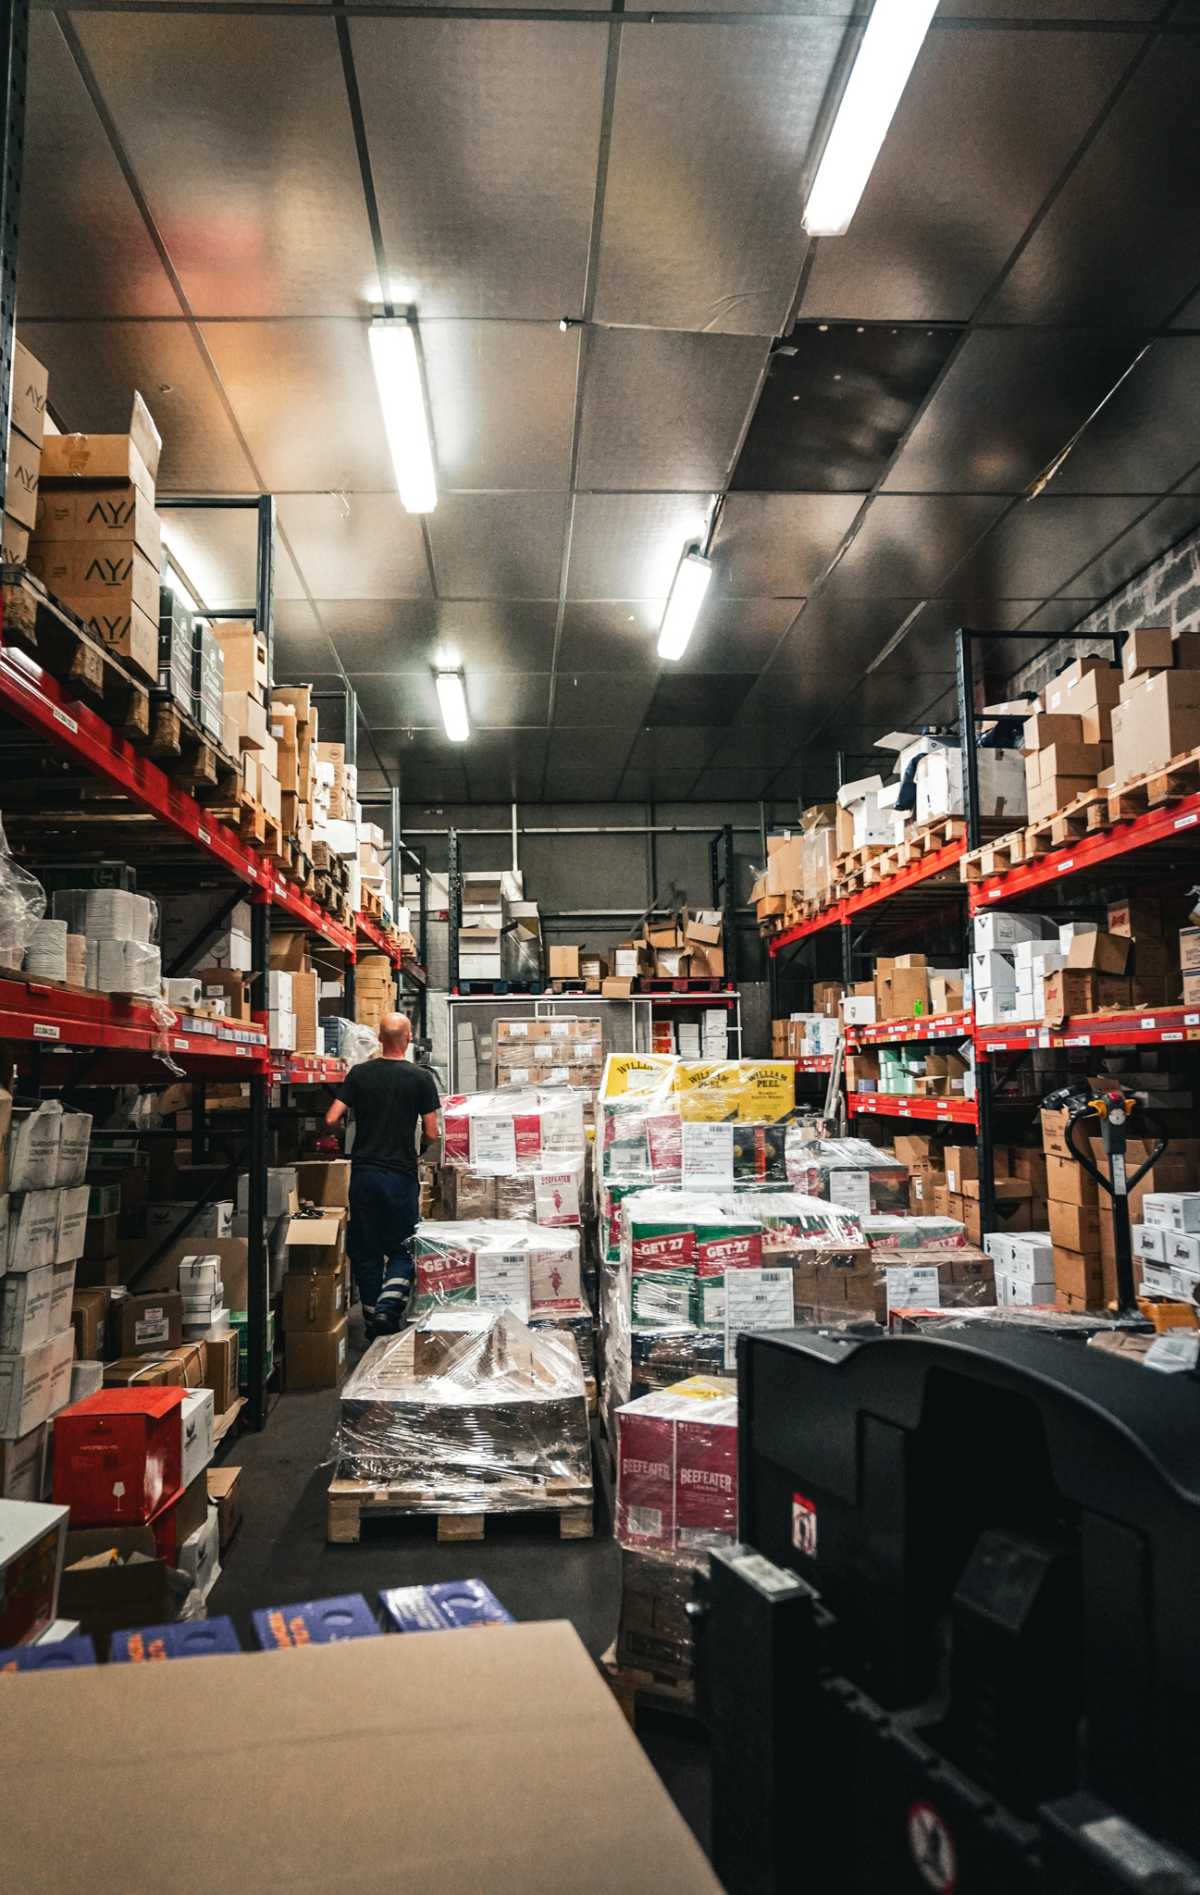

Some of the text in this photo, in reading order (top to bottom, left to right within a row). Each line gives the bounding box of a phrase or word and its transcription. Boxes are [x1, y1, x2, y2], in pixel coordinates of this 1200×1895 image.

[748, 1070, 788, 1082] WILLIAM
[757, 1079, 780, 1088] PEEL
[642, 1237, 684, 1255] GET 27
[706, 1240, 750, 1258] GET 27
[424, 1247, 453, 1273] GET
[623, 1458, 670, 1481] BEEFEATER
[680, 1468, 732, 1493] BEEFEATER
